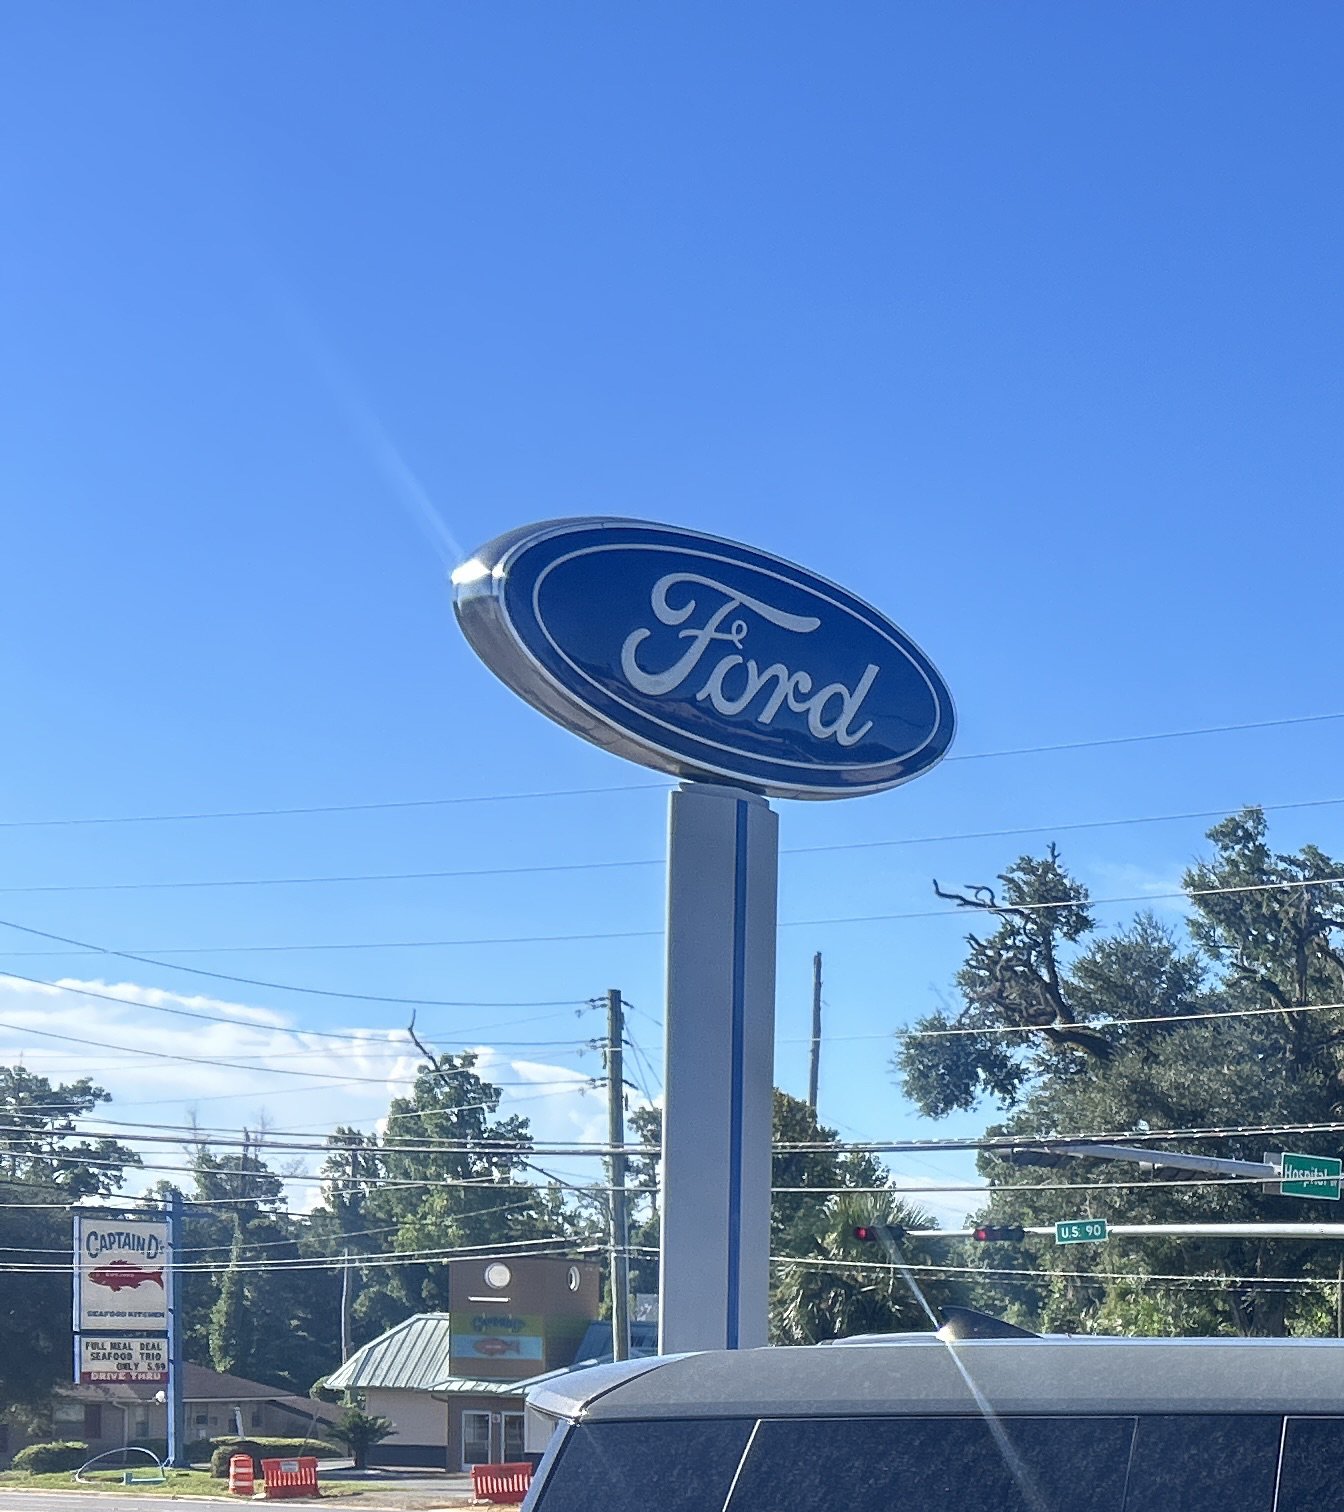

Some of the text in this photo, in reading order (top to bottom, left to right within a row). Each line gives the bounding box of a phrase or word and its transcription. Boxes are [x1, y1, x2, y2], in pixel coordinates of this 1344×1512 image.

[621, 572, 880, 747] Ford
[1284, 1164, 1328, 1188] Hospital
[1085, 1224, 1101, 1237] 90
[87, 1310, 127, 1318] SEAFOOD
[85, 1341, 162, 1351] FULL MEAL DEAL
[90, 1352, 162, 1361] SEAFOOD TRIO
[116, 1362, 140, 1371] ONLY
[90, 1372, 162, 1381] DRIVE THRU
